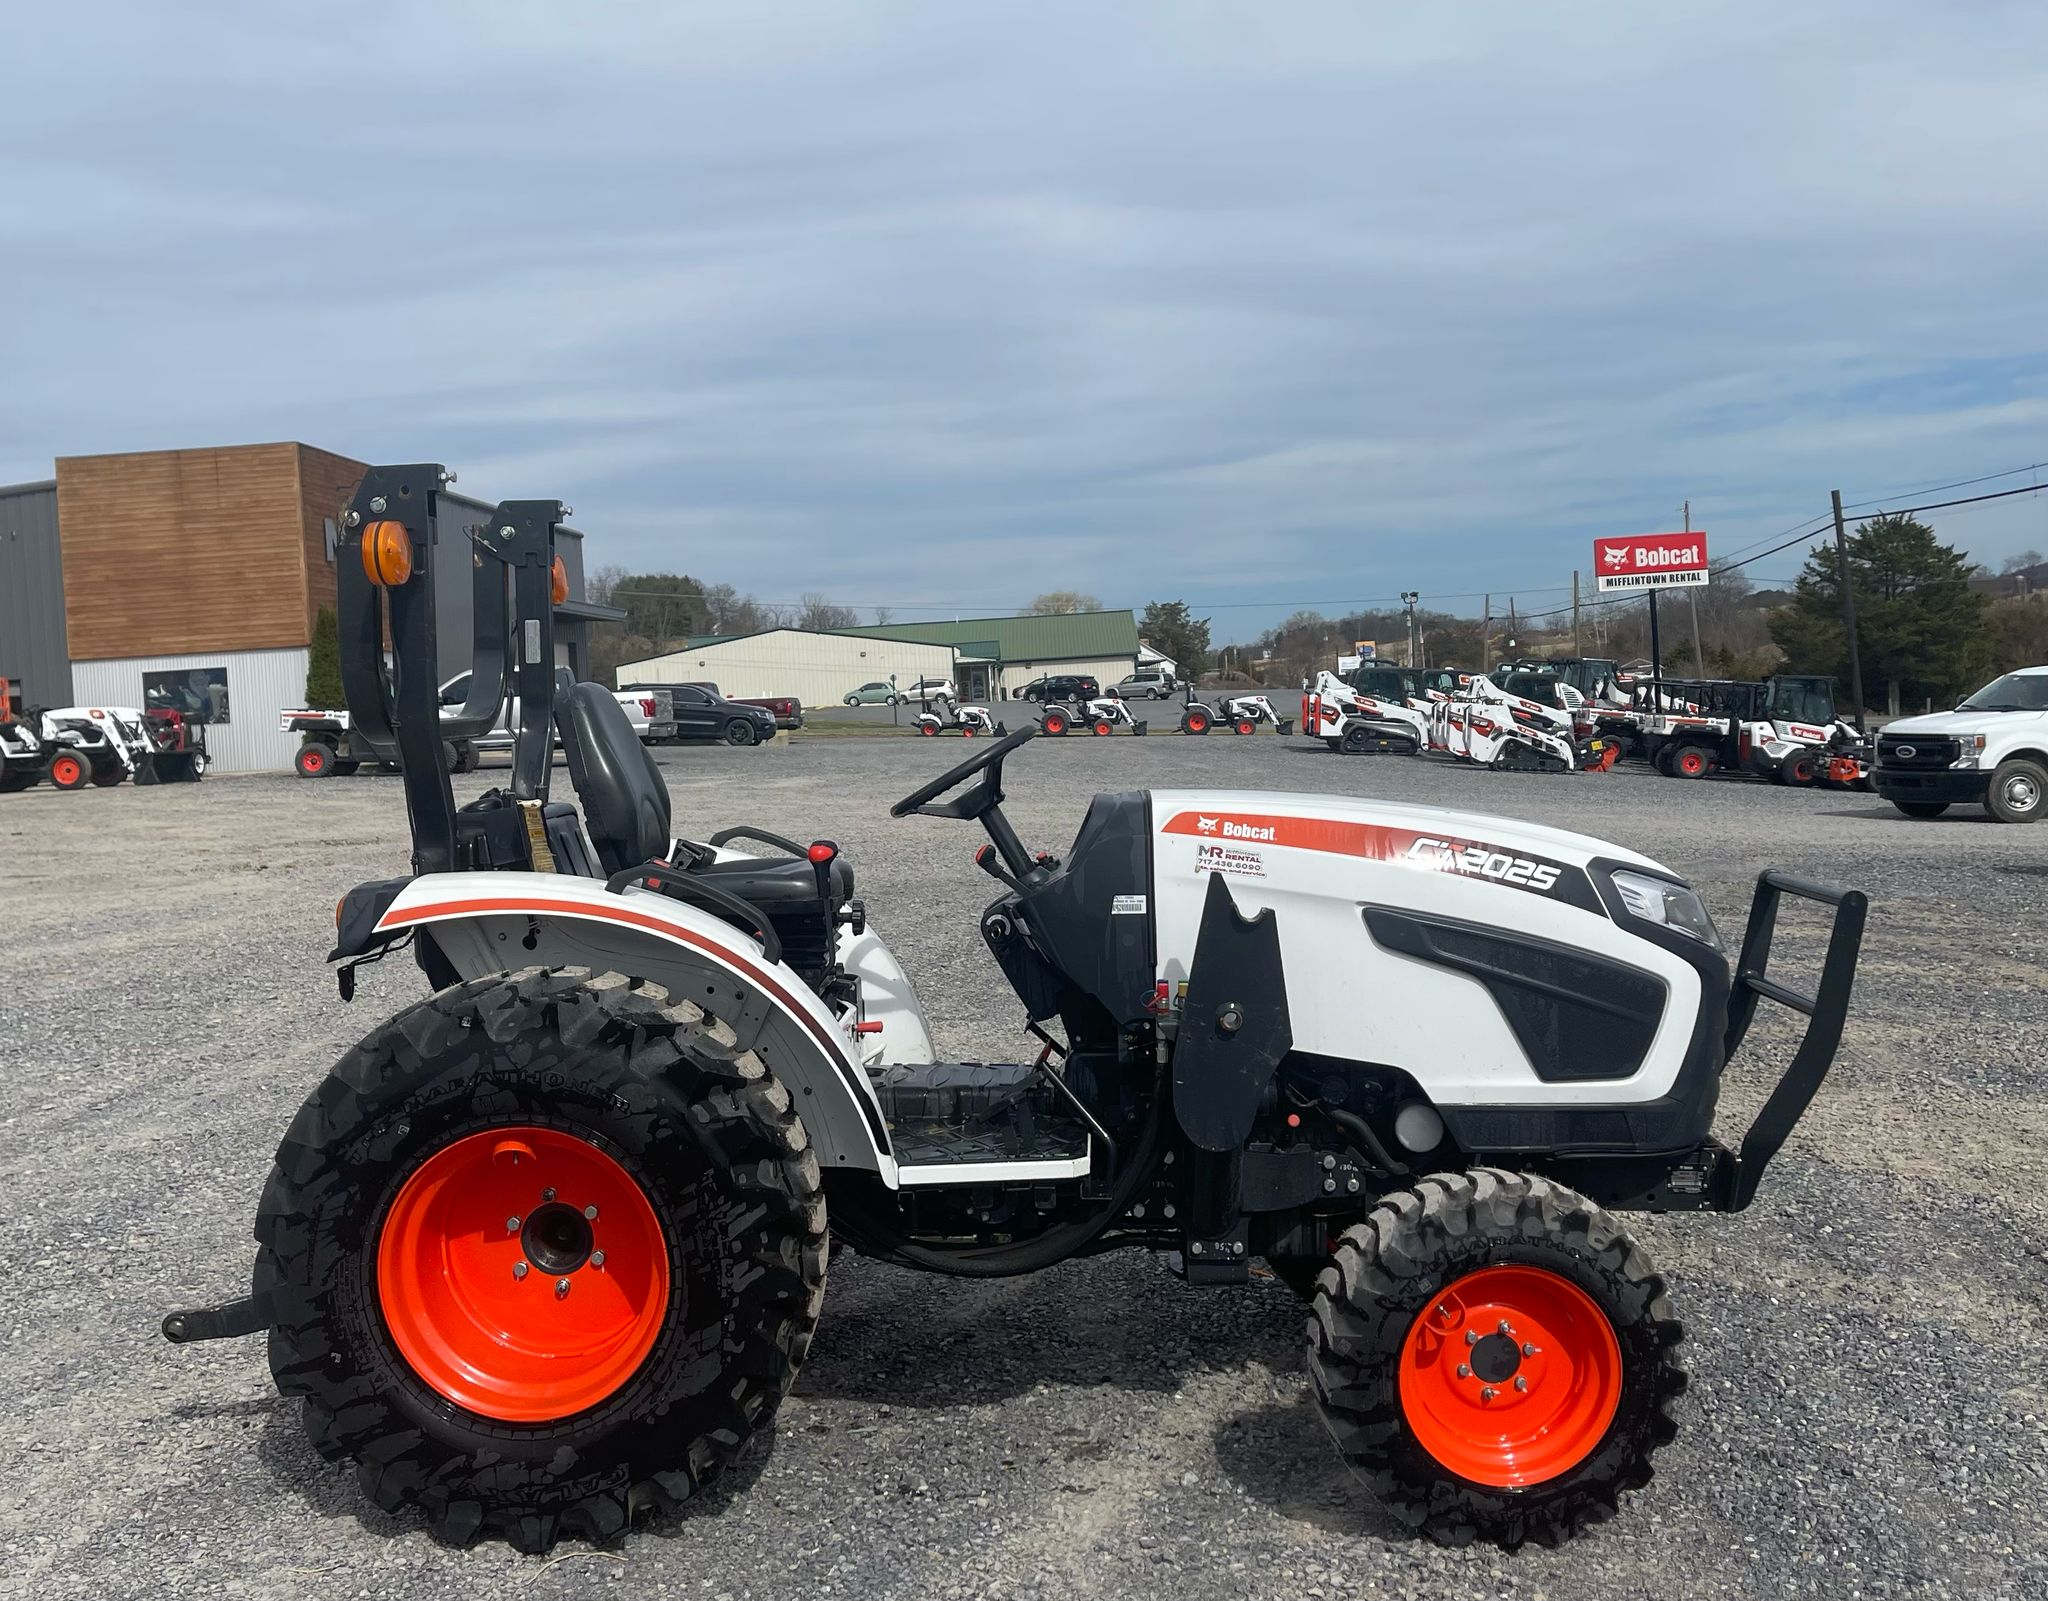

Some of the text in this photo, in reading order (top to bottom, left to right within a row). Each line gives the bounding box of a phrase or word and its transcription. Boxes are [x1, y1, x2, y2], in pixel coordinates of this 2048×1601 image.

[1635, 545, 1699, 567] Bobcat
[1606, 572, 1701, 587] MIFFLINTOWN RENTAL
[1223, 821, 1275, 840] Bobcat
[1198, 858, 1261, 871] 717.436.6090
[1225, 854, 1261, 863] RENTAL
